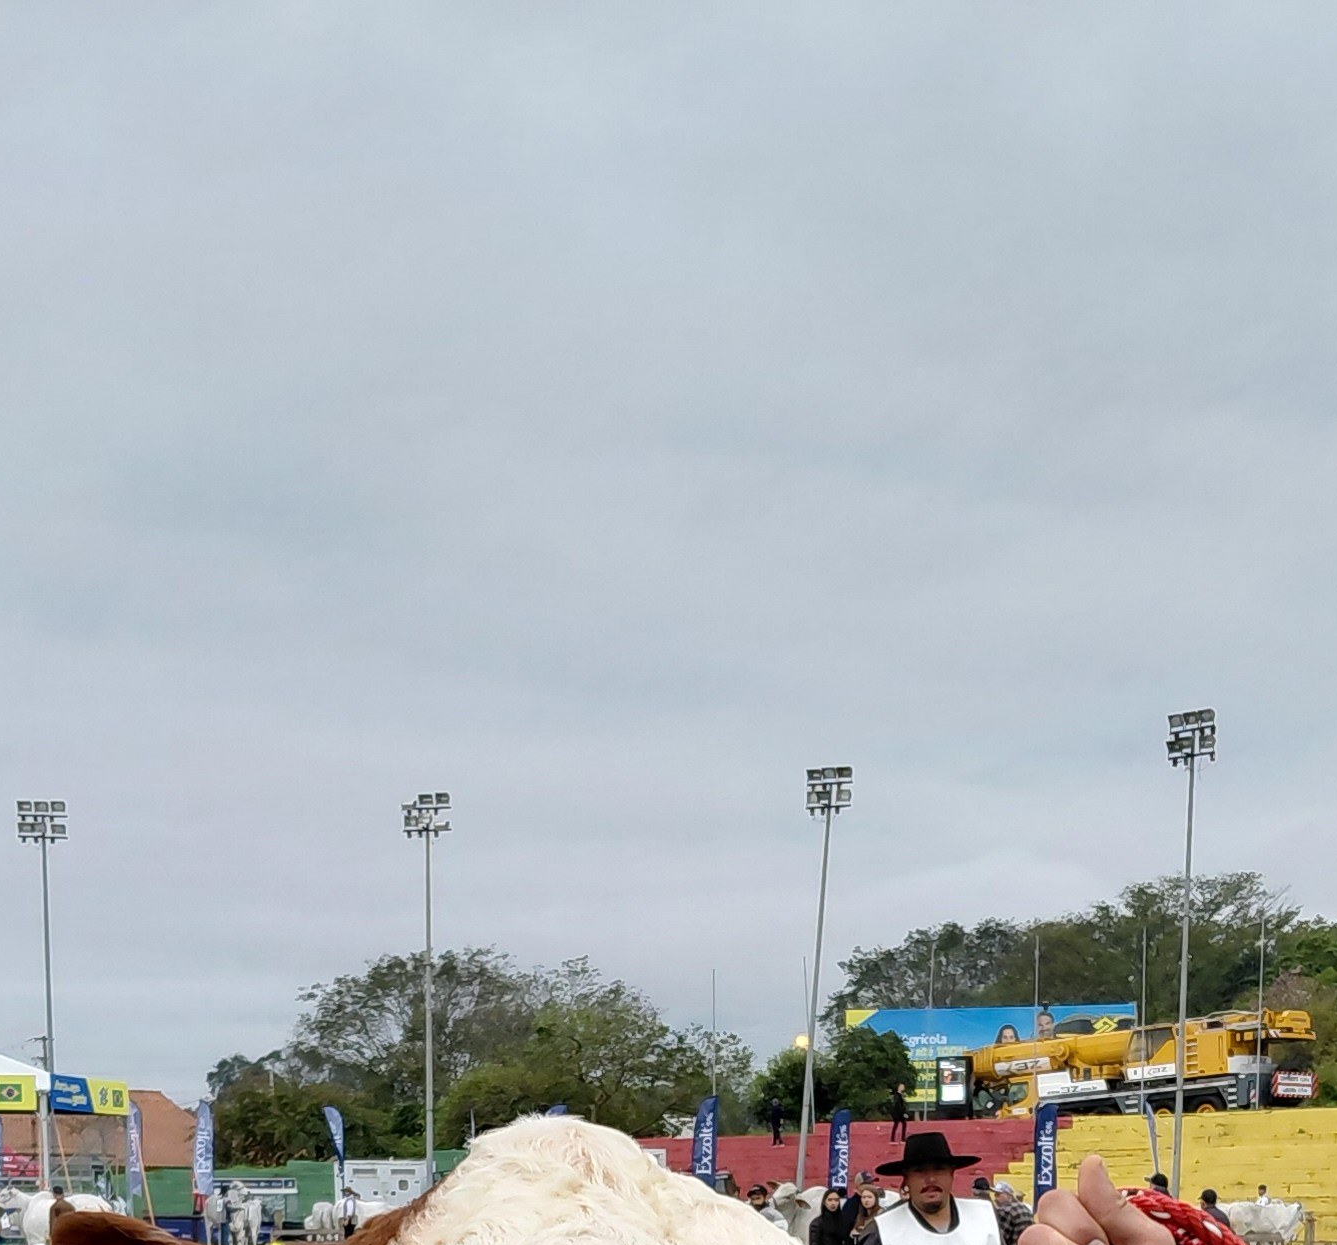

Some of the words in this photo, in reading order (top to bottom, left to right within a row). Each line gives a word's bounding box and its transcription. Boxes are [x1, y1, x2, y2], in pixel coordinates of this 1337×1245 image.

[696, 1126, 713, 1175] Exzolt
[832, 1136, 848, 1189] Exzolt
[1037, 1133, 1054, 1187] Exzolt
